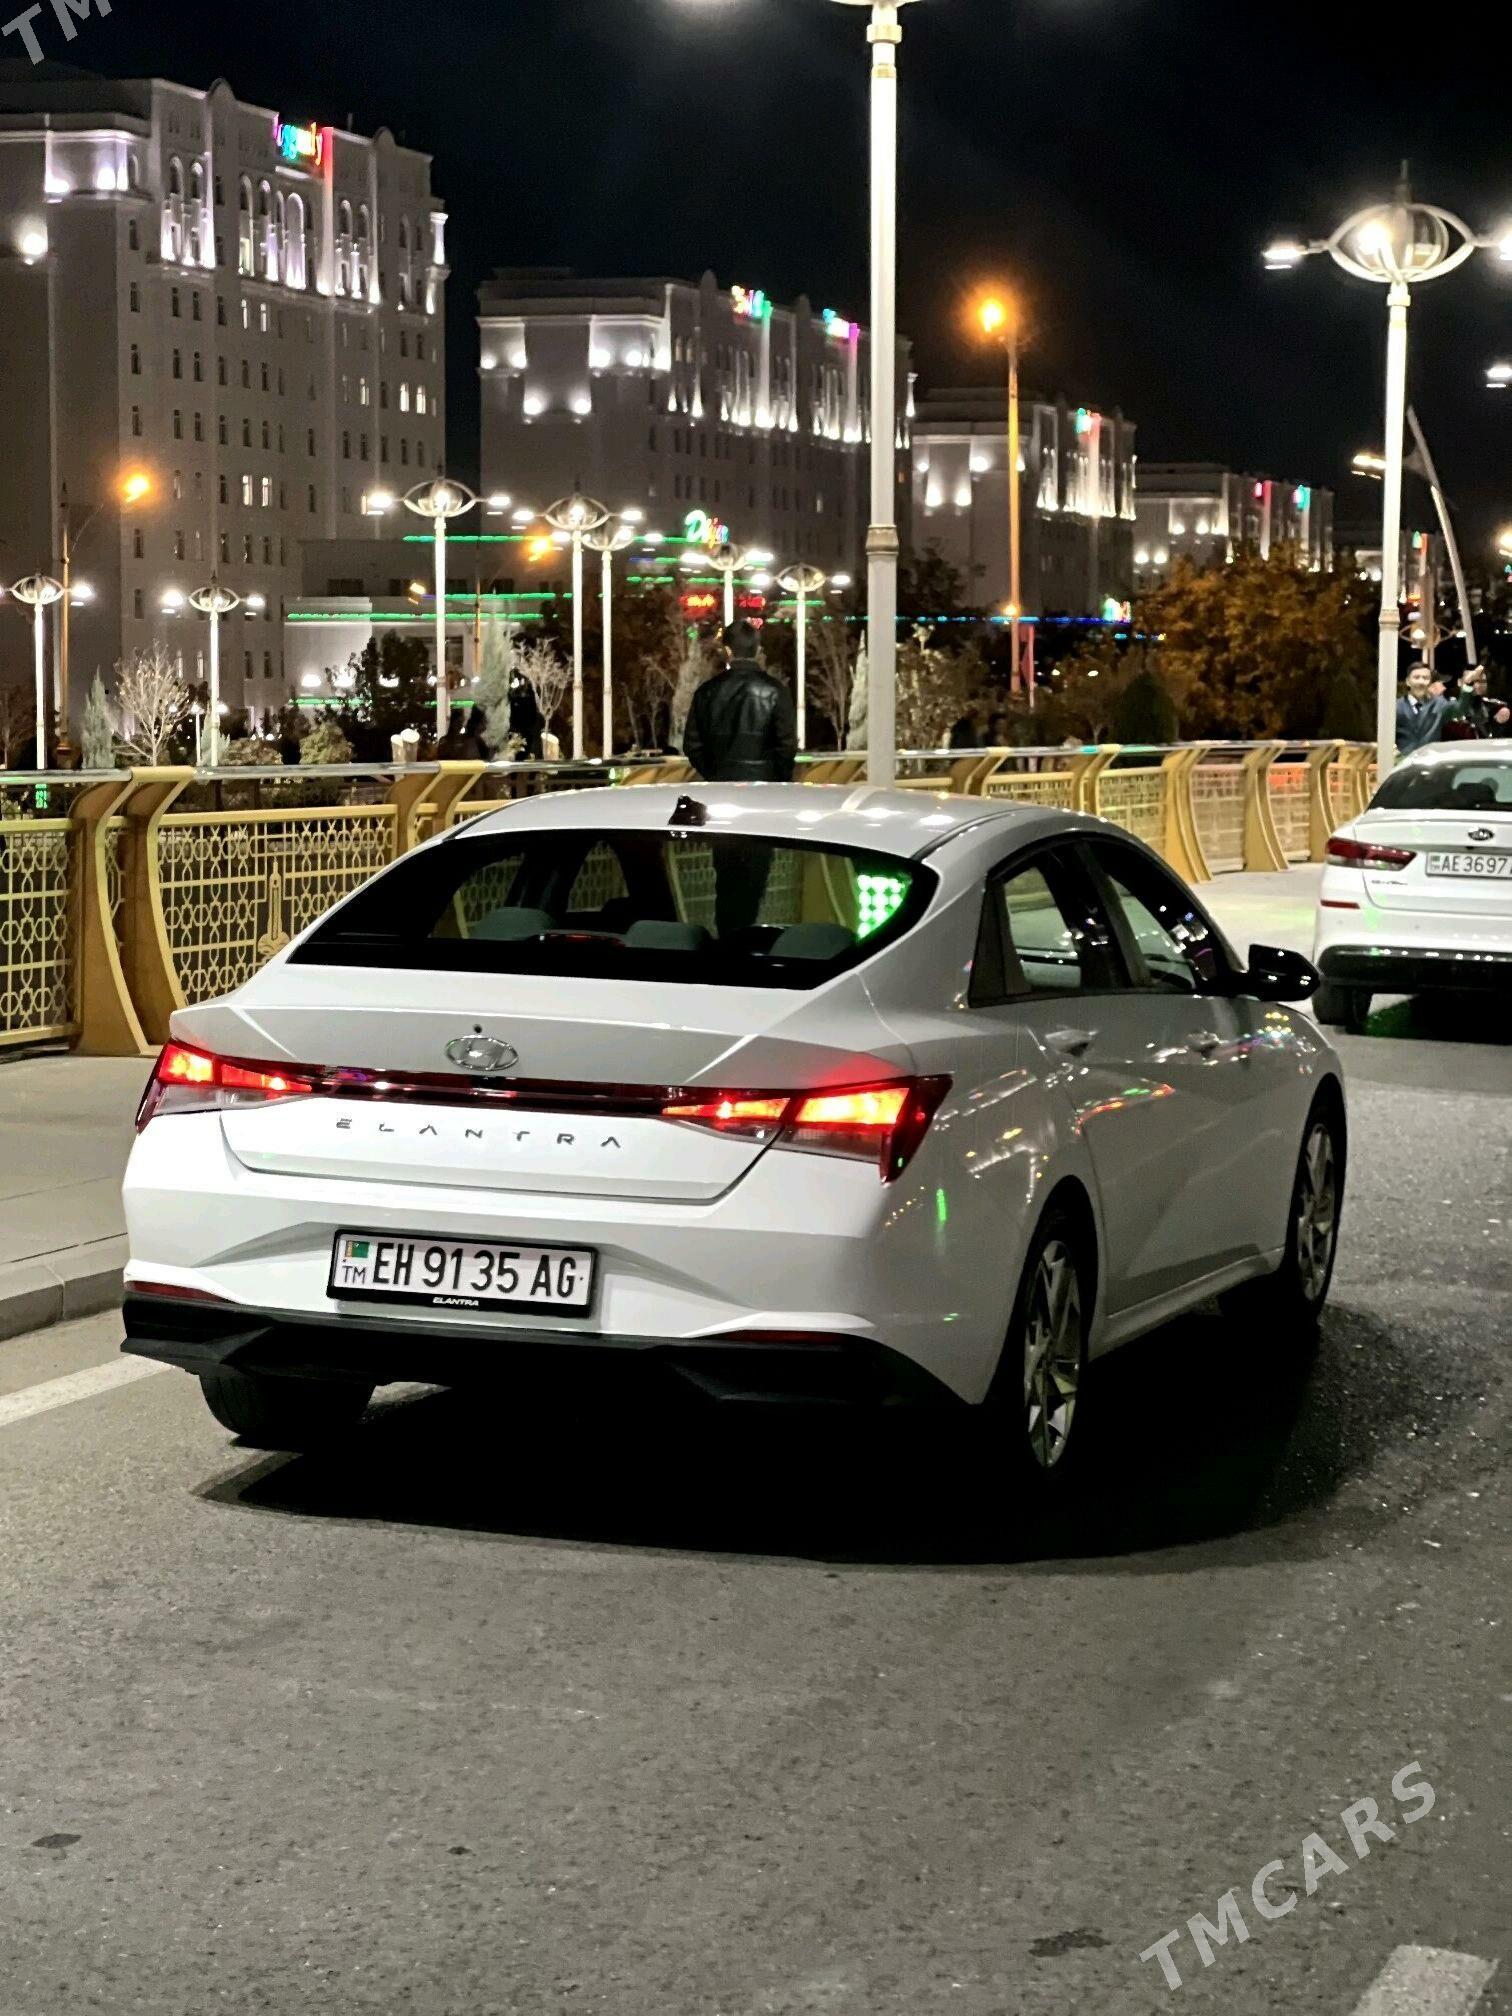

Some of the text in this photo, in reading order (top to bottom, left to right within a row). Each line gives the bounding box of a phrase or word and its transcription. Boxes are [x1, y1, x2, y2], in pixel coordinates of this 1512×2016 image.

[1441, 855, 1508, 874] AE 3697
[335, 1118, 621, 1149] ELANTRA
[342, 1242, 577, 1298] TM EH 9135 AG
[432, 1296, 480, 1308] ELANTRA
